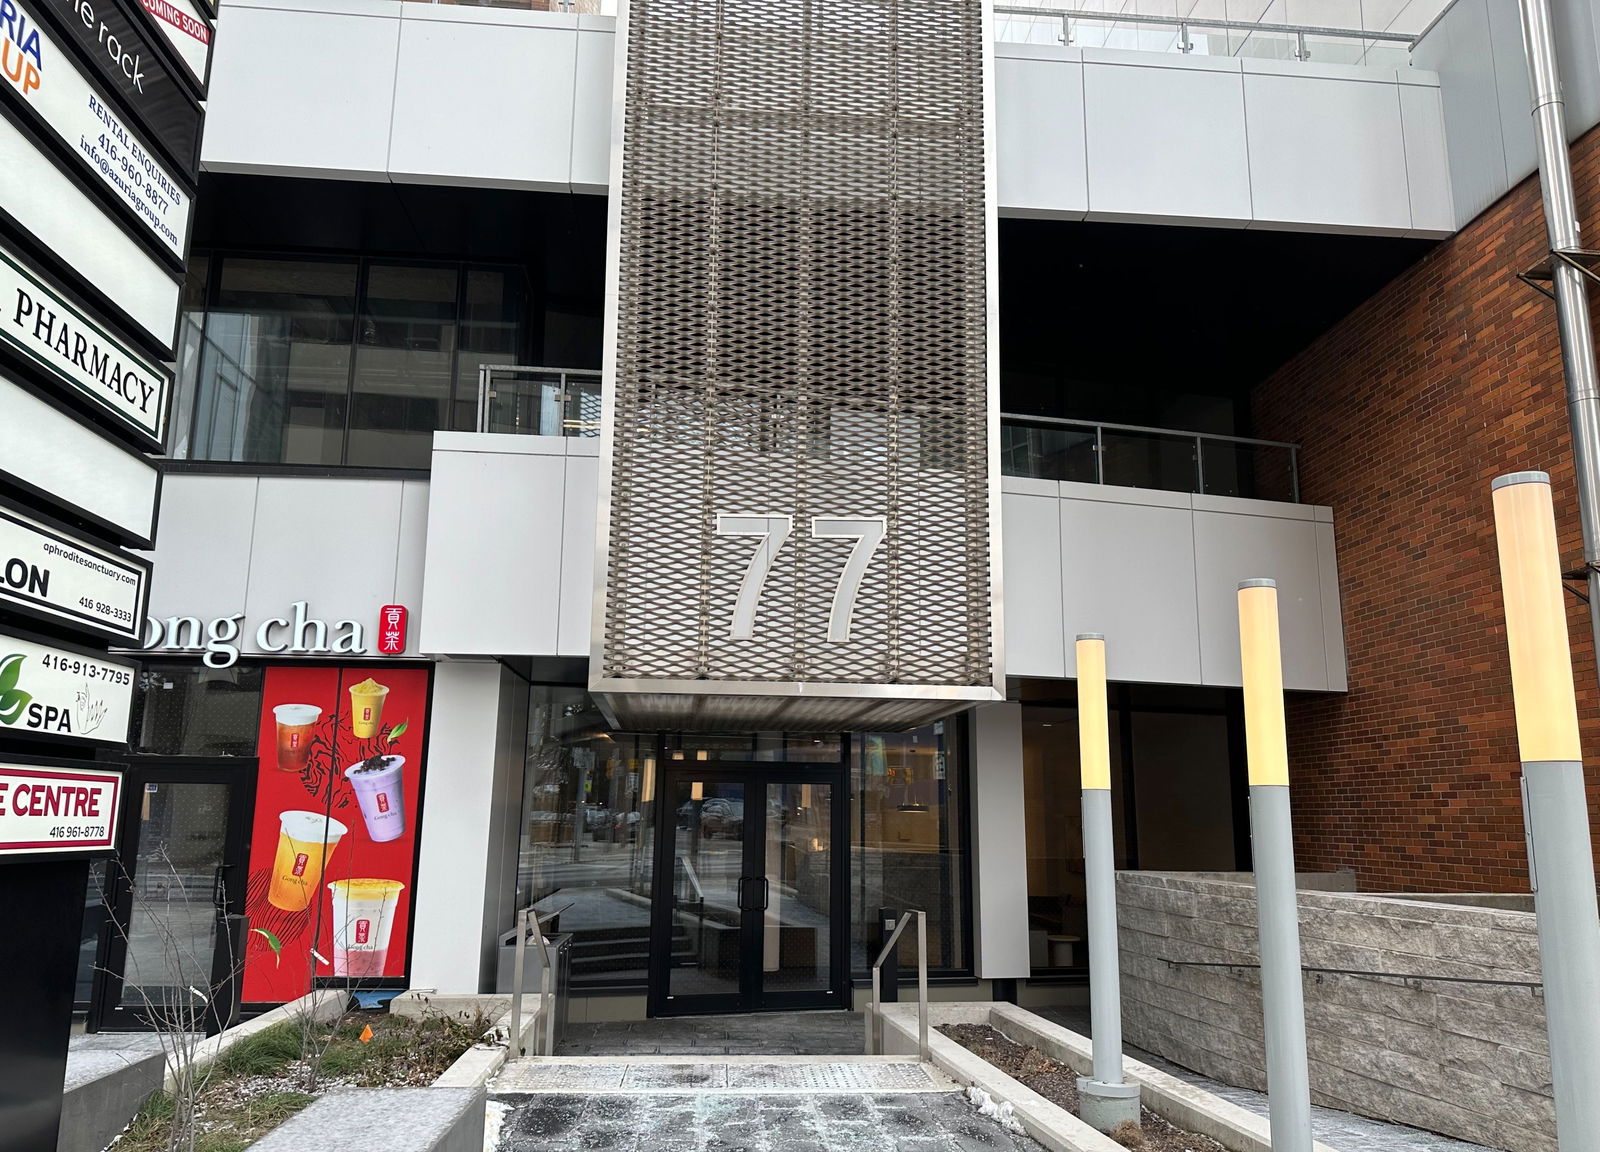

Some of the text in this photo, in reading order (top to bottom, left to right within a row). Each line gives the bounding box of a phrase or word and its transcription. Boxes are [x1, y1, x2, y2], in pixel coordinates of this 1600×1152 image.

[0, 0, 42, 72] RIA
[182, 15, 207, 41] SOON
[2, 36, 41, 95] UP
[98, 21, 145, 94] rack
[88, 94, 181, 206] RENTAL ENQUIRIES
[98, 133, 169, 215] 416-960-8877
[80, 135, 178, 246] info@azuriagroup.com
[13, 287, 154, 414] PHARMACY
[0, 557, 50, 598] ON
[43, 542, 136, 586] aphroditesanctuary.com
[717, 513, 887, 643] 77
[79, 596, 132, 622] 416 928-3333
[256, 601, 366, 653] cha
[42, 654, 130, 685] 416-913-7795
[27, 702, 72, 733] SPA
[12, 783, 102, 817] CENTRE
[50, 826, 105, 838] 416 961-8778
